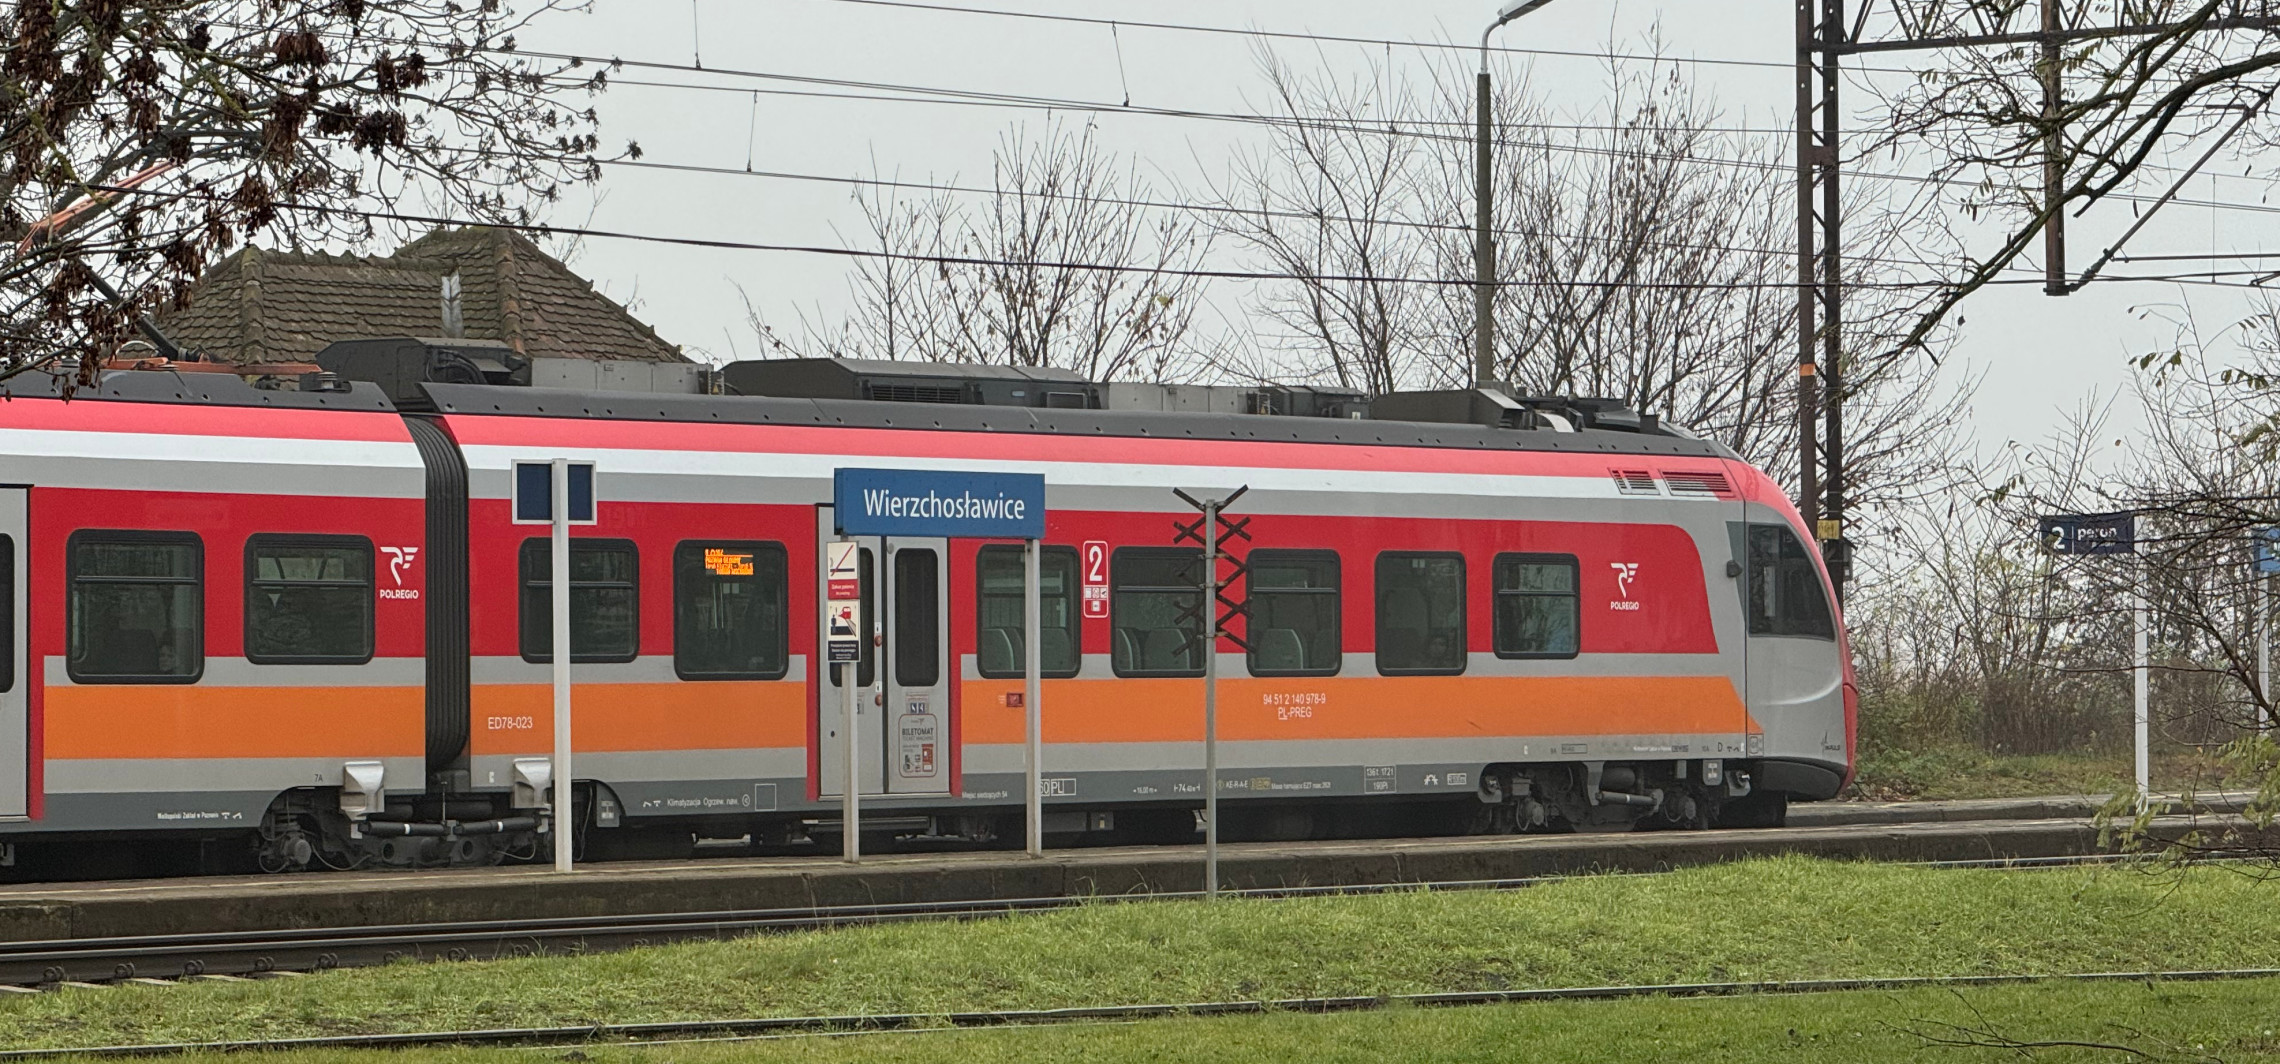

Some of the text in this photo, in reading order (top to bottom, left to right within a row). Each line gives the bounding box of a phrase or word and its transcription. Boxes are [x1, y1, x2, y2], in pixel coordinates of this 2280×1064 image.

[863, 488, 1025, 520] Wierzchosławice
[2051, 526, 2117, 550] 2 peron
[1089, 545, 1103, 582] 2
[379, 589, 419, 600] POLREGIO
[1610, 601, 1640, 611] POLREGIO
[1263, 693, 1326, 705] 94 51 2 140 978-9
[1278, 706, 1312, 720] PL-PREG
[487, 716, 533, 730] ED78-023
[902, 727, 934, 736] BILETOMAT
[667, 797, 701, 808] Klimatyzacja
